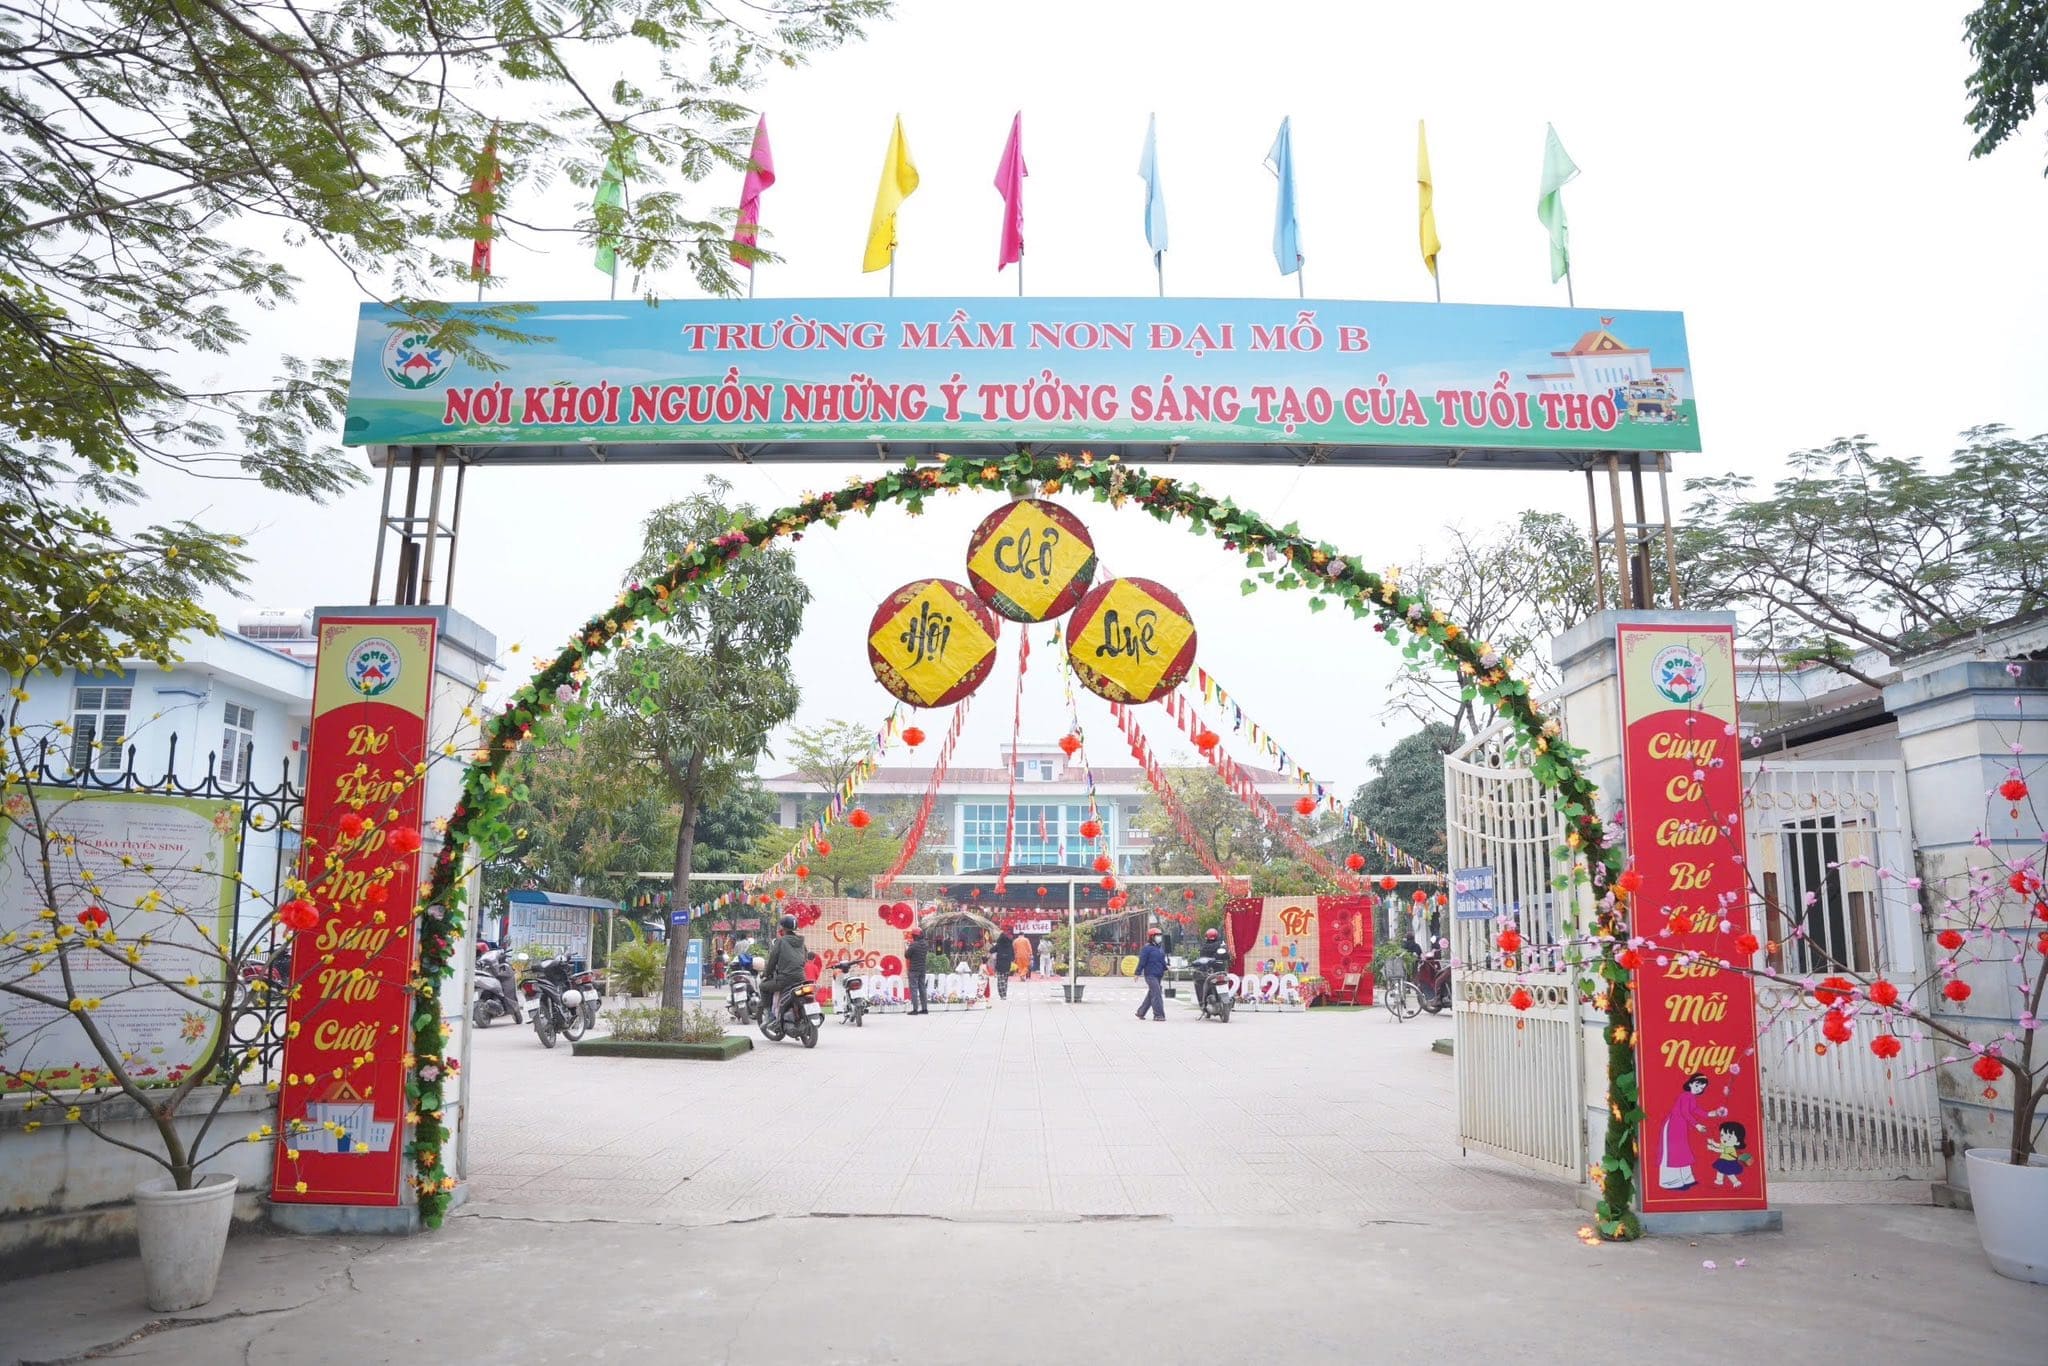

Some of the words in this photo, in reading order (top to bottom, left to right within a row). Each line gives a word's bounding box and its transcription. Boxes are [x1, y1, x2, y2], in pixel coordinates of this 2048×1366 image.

[685, 315, 886, 349] TRƯỜNG
[901, 310, 1015, 349] MẦM
[1030, 322, 1134, 349] NON
[1149, 323, 1235, 356] ĐẠI
[1251, 311, 1323, 351] MỖ
[1338, 326, 1369, 352] B
[444, 381, 512, 424] NƠI
[522, 380, 620, 424] KHƠI
[630, 366, 774, 422] NGUỒN
[783, 373, 928, 421] NHỮNG
[940, 373, 968, 421] Ý
[978, 369, 1119, 421] TƯỞNG
[1131, 374, 1240, 422] SÁNG
[1251, 386, 1334, 434] TẠO
[1344, 373, 1429, 425] CỦA
[1436, 371, 1532, 429] TUỔI
[1540, 388, 1617, 430] THƠ
[900, 600, 953, 669] Hội
[345, 725, 393, 756] Bé
[1648, 732, 1717, 767] Cùng
[159, 842, 184, 852] SINH
[1656, 818, 1718, 848] Giáo
[1669, 862, 1715, 891] Bé
[316, 918, 390, 959] Sáng
[1665, 992, 1729, 1025] Mỗi
[314, 1019, 380, 1051] Cười
[1661, 1039, 1737, 1075] Ngày
